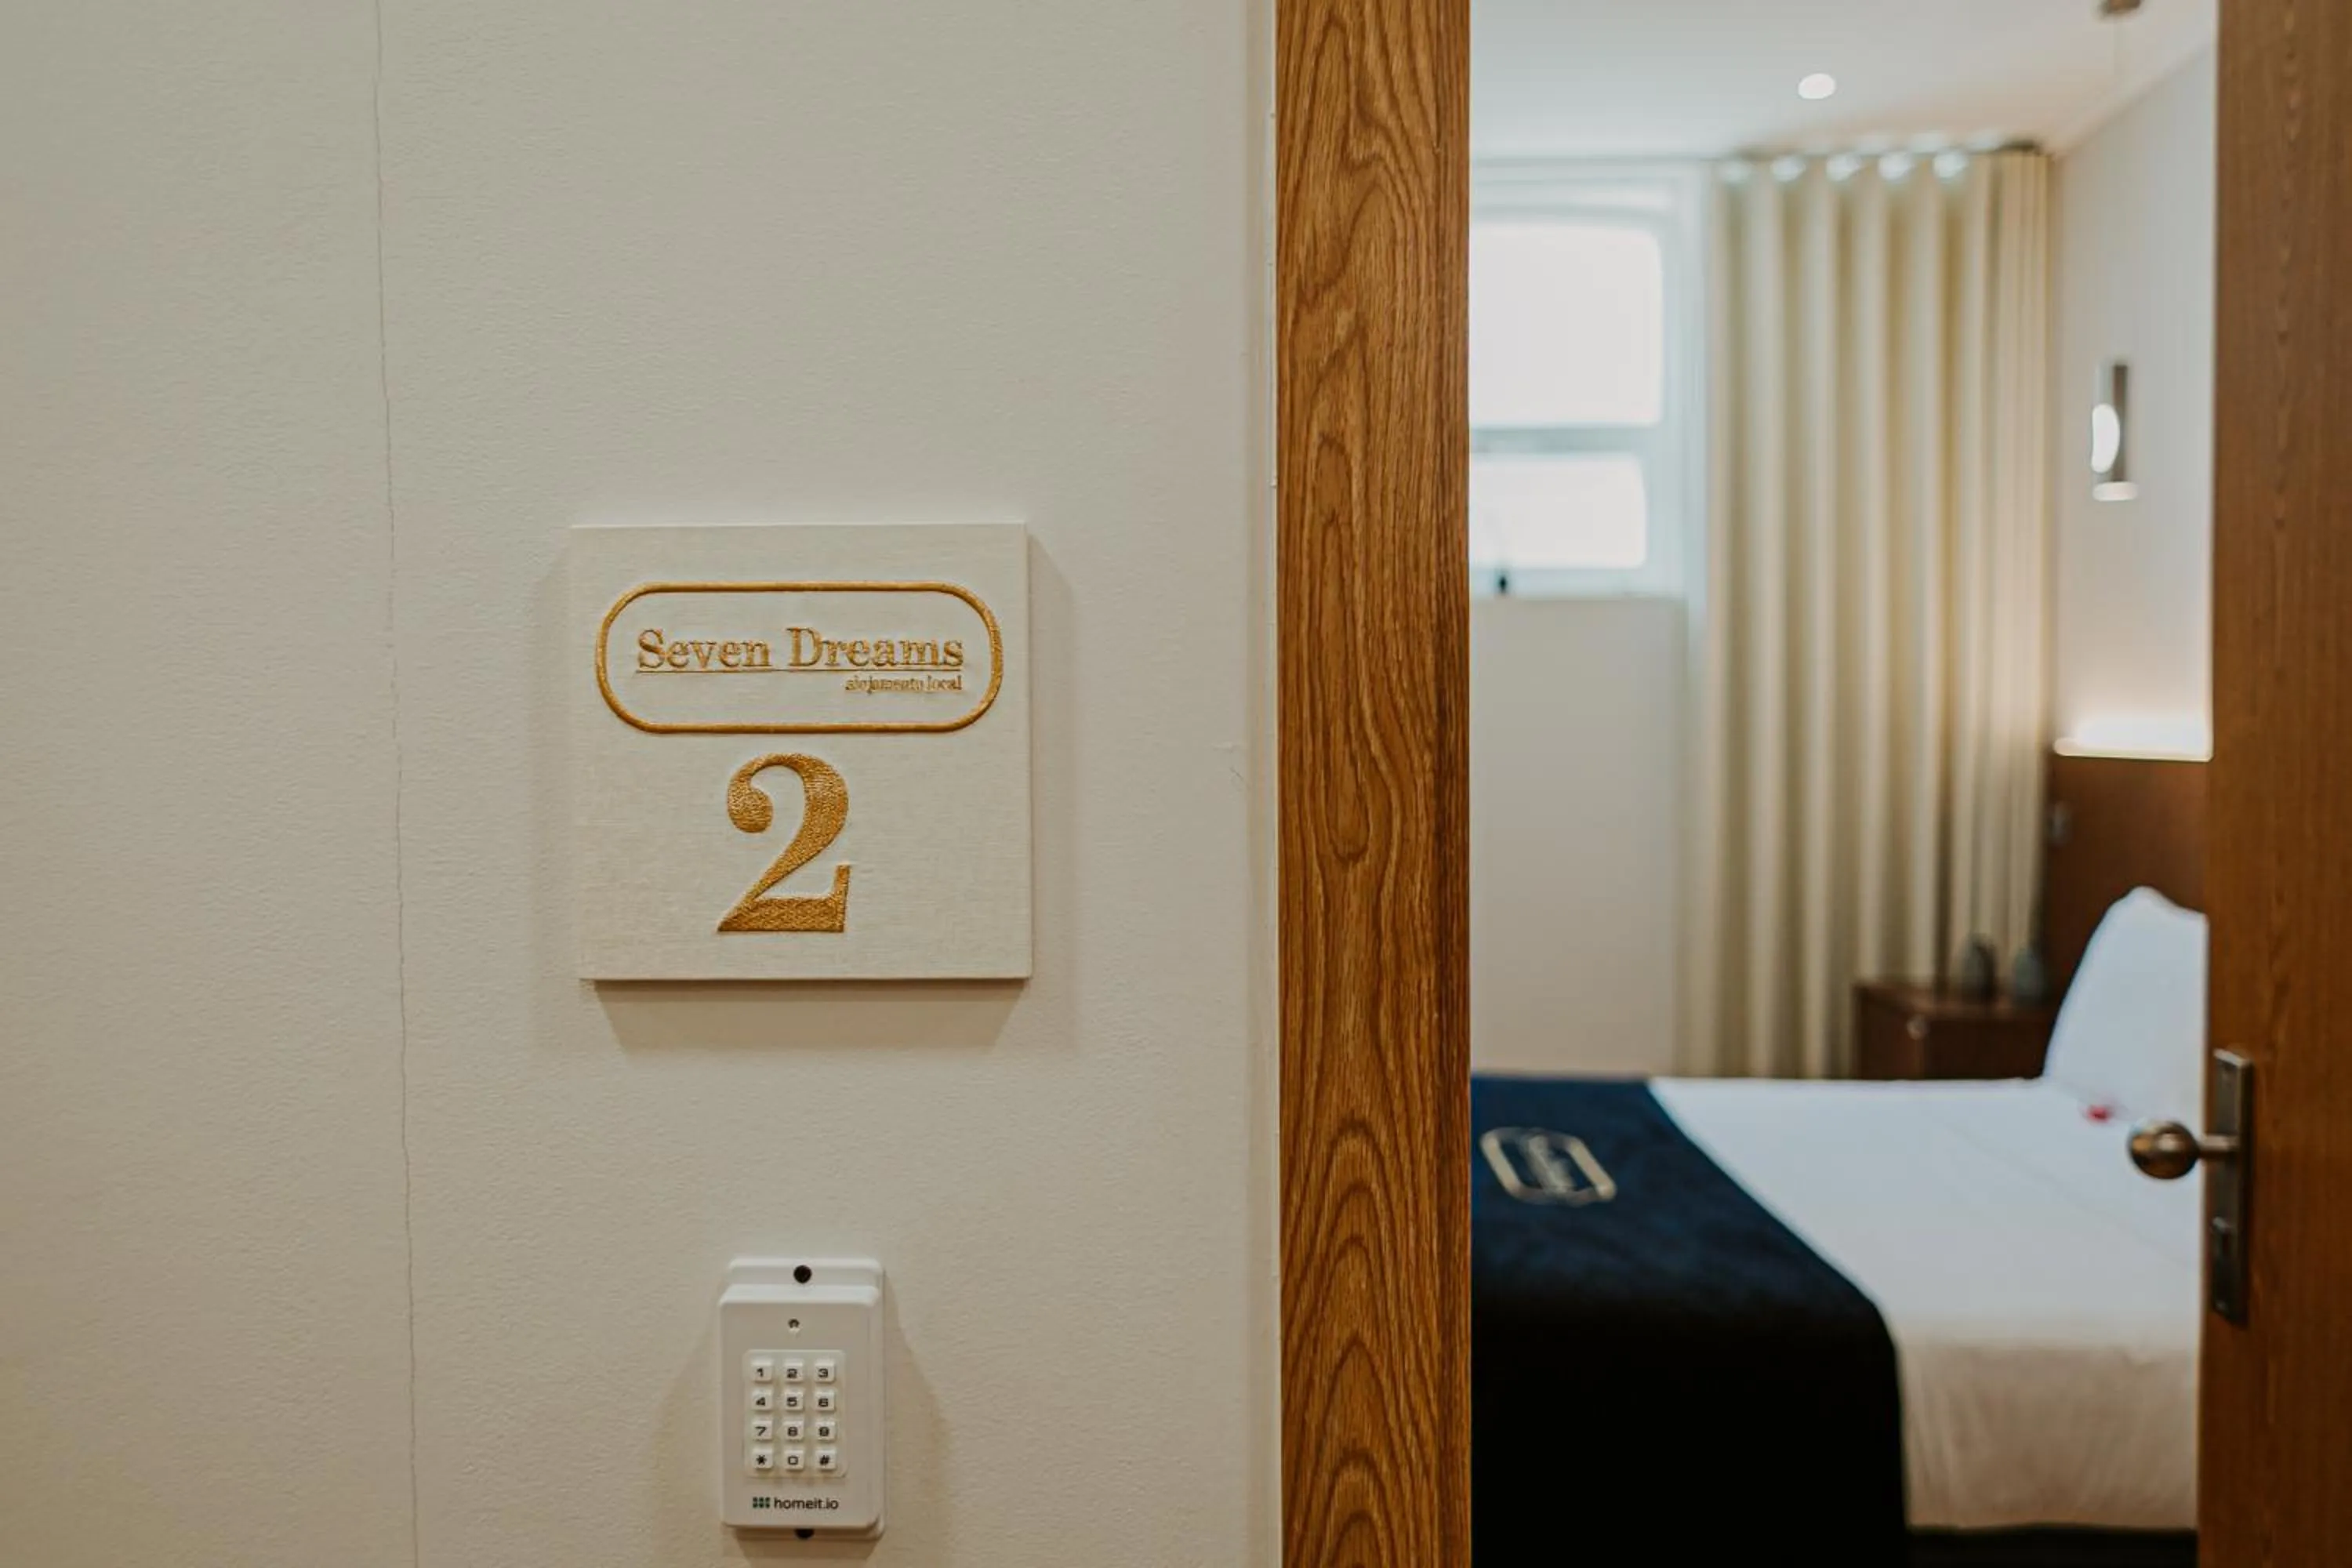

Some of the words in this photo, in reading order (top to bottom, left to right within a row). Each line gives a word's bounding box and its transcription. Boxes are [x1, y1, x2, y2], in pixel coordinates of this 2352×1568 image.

[637, 629, 772, 669] Seven
[786, 626, 964, 668] Dreams
[924, 674, 963, 691] local
[717, 752, 851, 933] 2
[757, 1367, 764, 1377] 1
[786, 1368, 797, 1378] 2
[818, 1368, 829, 1378] 3
[756, 1396, 766, 1406] 4
[786, 1396, 797, 1406] 5
[818, 1397, 829, 1407] 6
[755, 1426, 767, 1436] 7
[787, 1426, 798, 1437] 8
[818, 1426, 829, 1437] 9
[787, 1456, 798, 1465] 0
[819, 1455, 829, 1465] #
[774, 1497, 839, 1509] homeit.io
